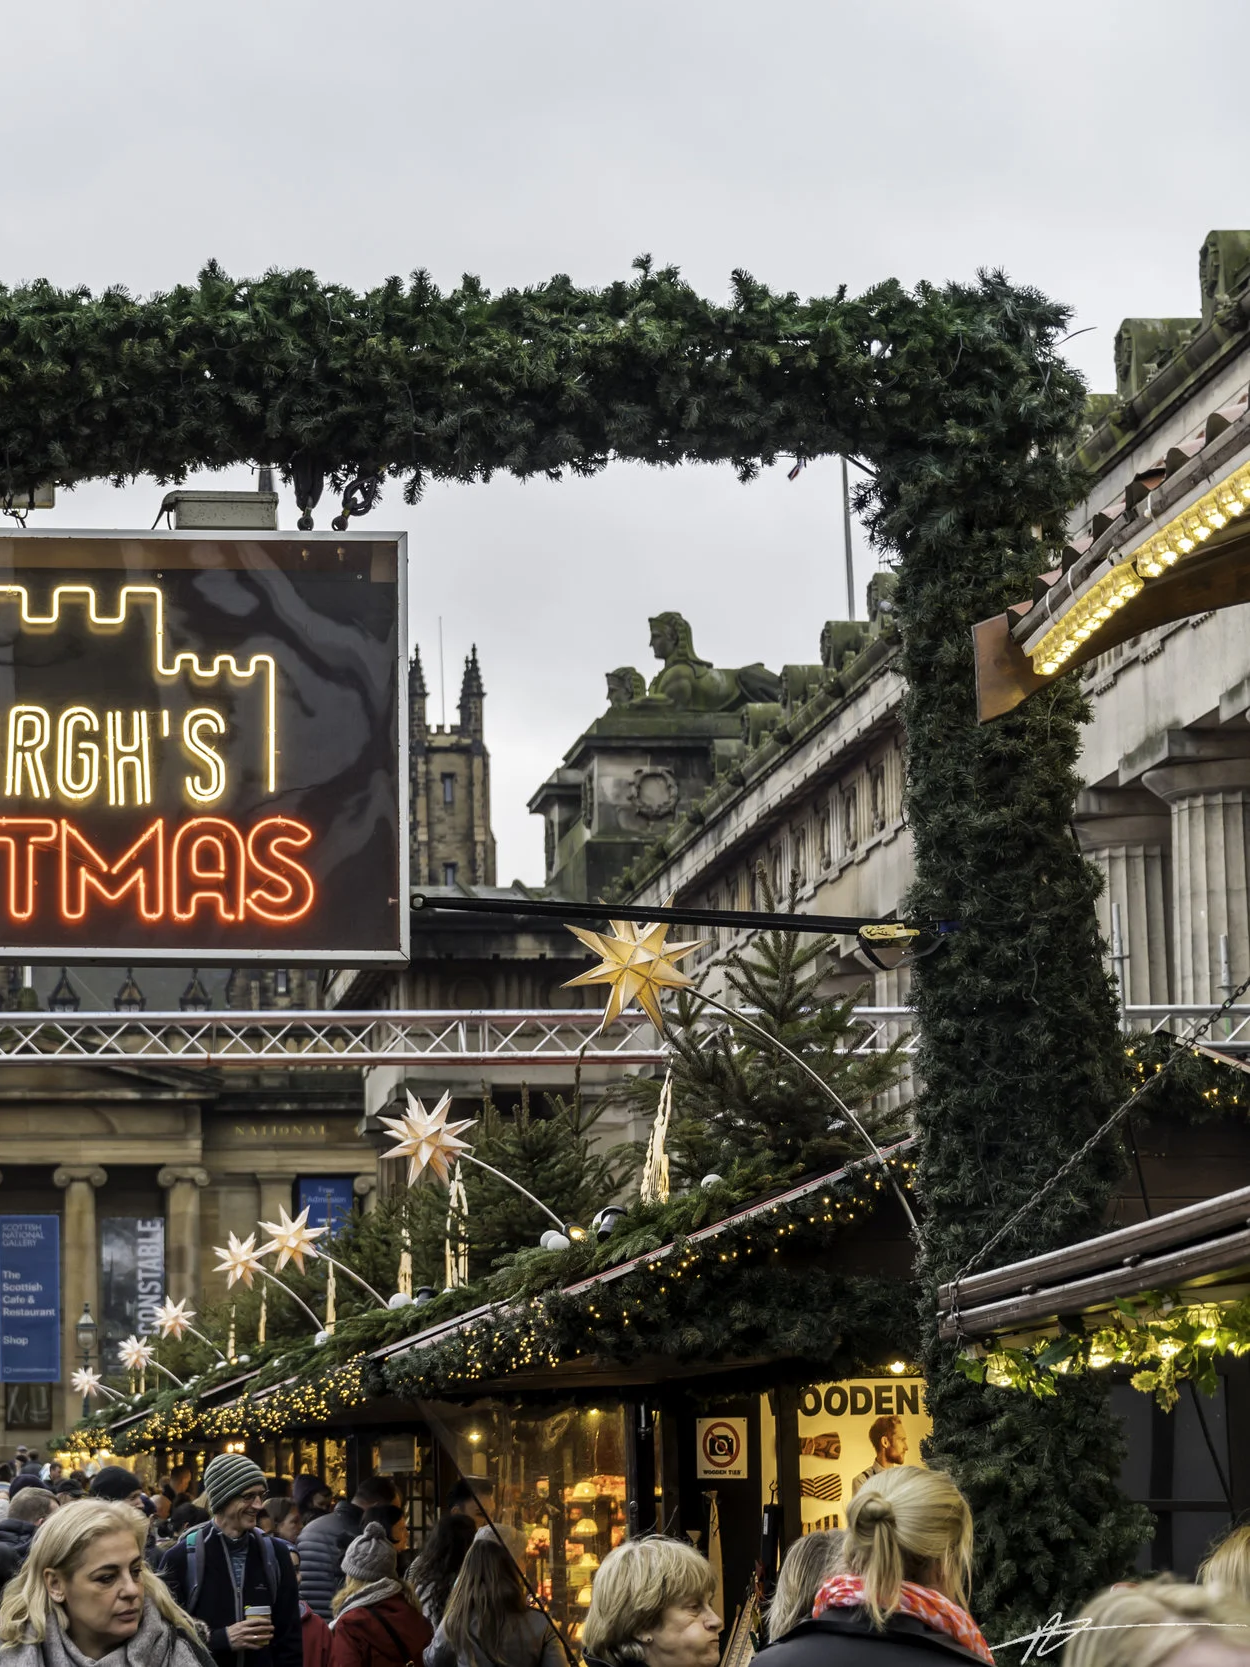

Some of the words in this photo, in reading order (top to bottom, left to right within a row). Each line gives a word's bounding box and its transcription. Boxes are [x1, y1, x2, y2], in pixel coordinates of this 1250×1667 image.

[2, 1223, 42, 1231] SCOTTISH
[2, 1231, 45, 1239] NATIONAL
[2, 1239, 37, 1247] GALLERY
[2, 1270, 21, 1279] The
[137, 1219, 162, 1335] CONSTABLE
[2, 1282, 43, 1291] Scottish
[28, 1295, 35, 1304] &
[3, 1307, 56, 1317] Restaurant
[3, 1335, 29, 1346] Shop
